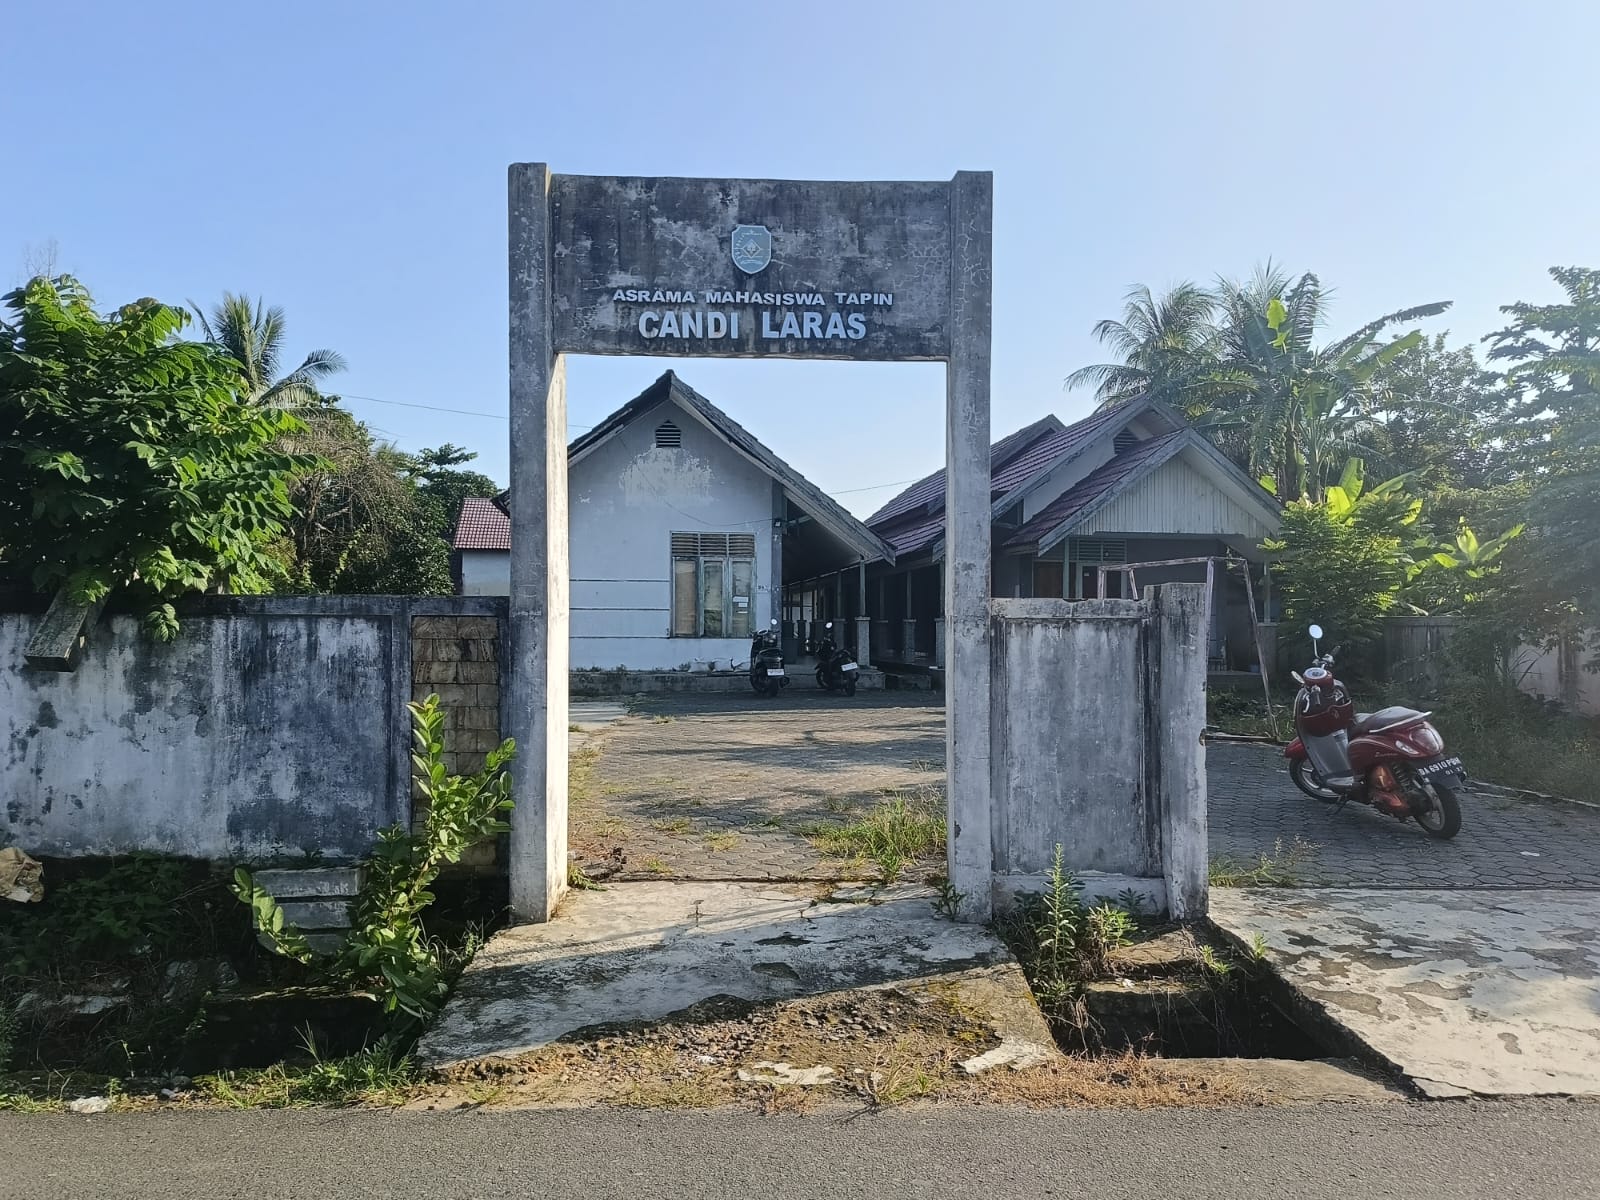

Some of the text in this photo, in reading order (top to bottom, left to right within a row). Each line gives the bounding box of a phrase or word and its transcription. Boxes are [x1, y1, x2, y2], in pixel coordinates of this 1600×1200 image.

[612, 289, 893, 306] ASRAMA MAHASISWA TAPIN
[638, 310, 867, 340] CANDI LARAS
[1429, 760, 1448, 773] 6910
